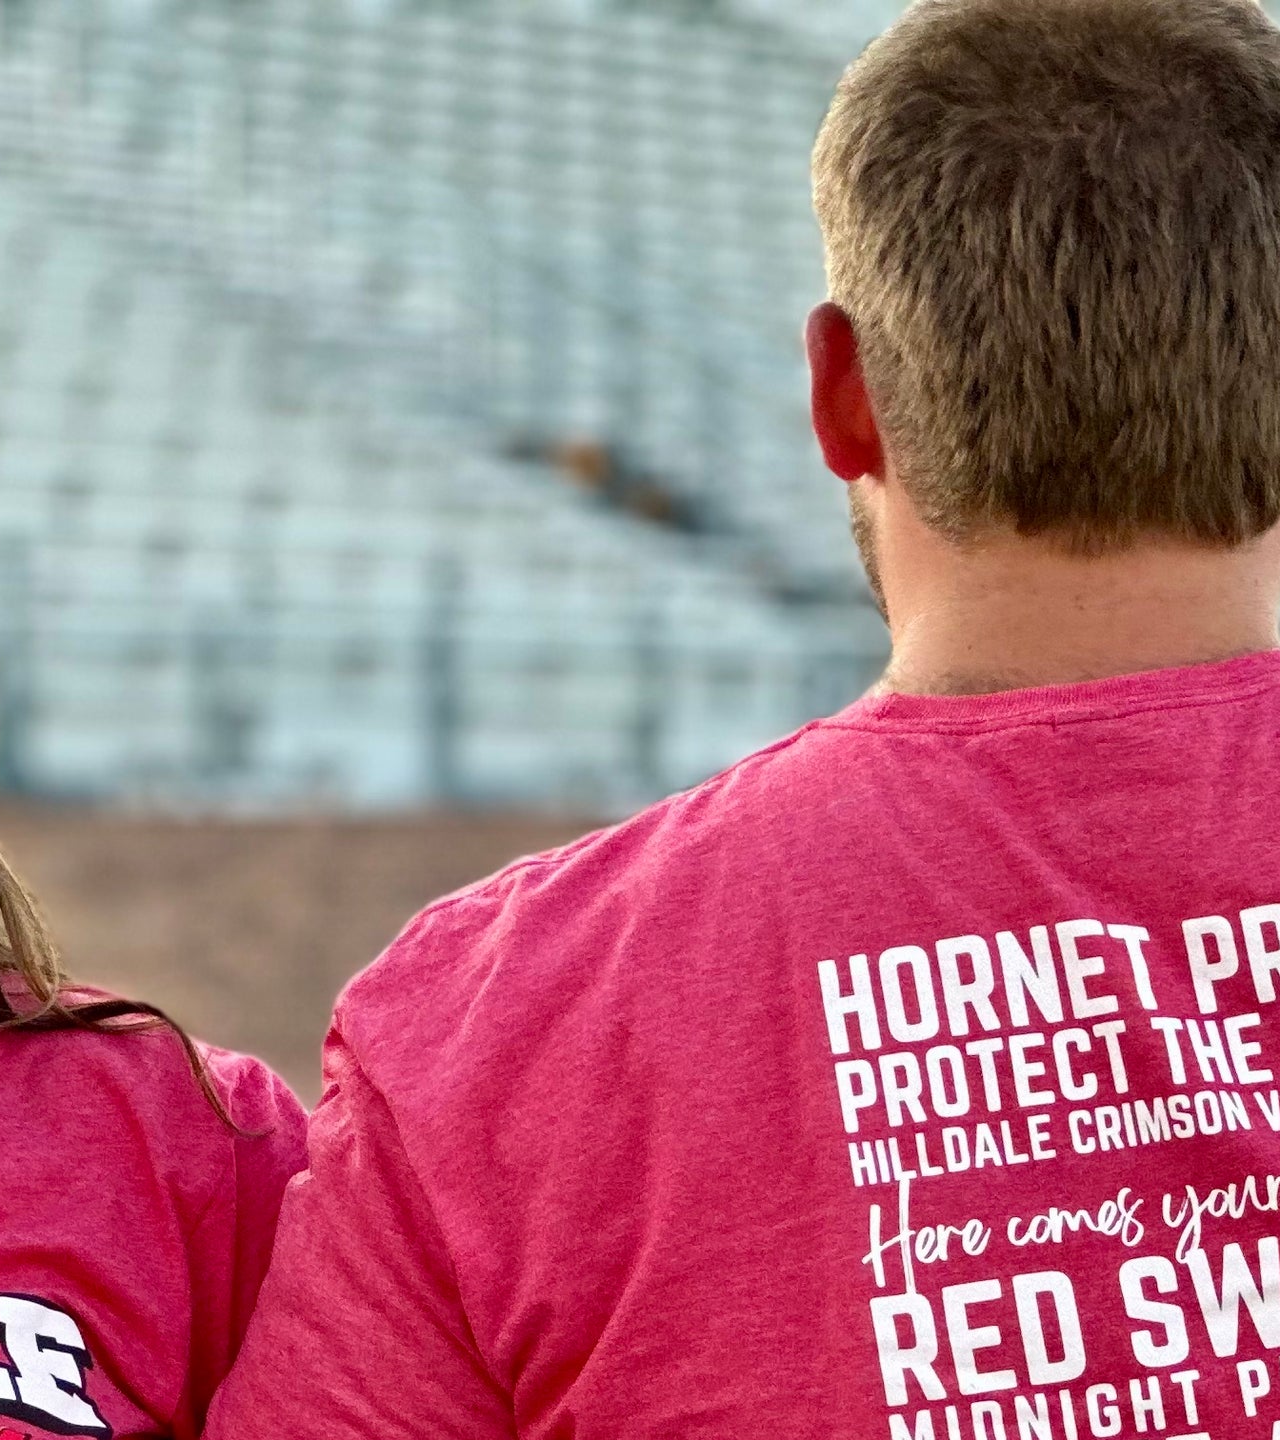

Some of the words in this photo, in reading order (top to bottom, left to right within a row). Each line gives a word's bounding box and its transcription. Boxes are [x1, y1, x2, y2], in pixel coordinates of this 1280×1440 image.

[818, 918, 1156, 1054] HORNET
[835, 1019, 1132, 1132] PROTECT
[1152, 1013, 1273, 1086] THE
[849, 1113, 1054, 1187] HILLDALE
[1071, 1089, 1251, 1151] CRIMSON
[862, 1175, 991, 1295] Here
[1007, 1187, 1144, 1247] comes
[870, 1270, 1086, 1408] RED
